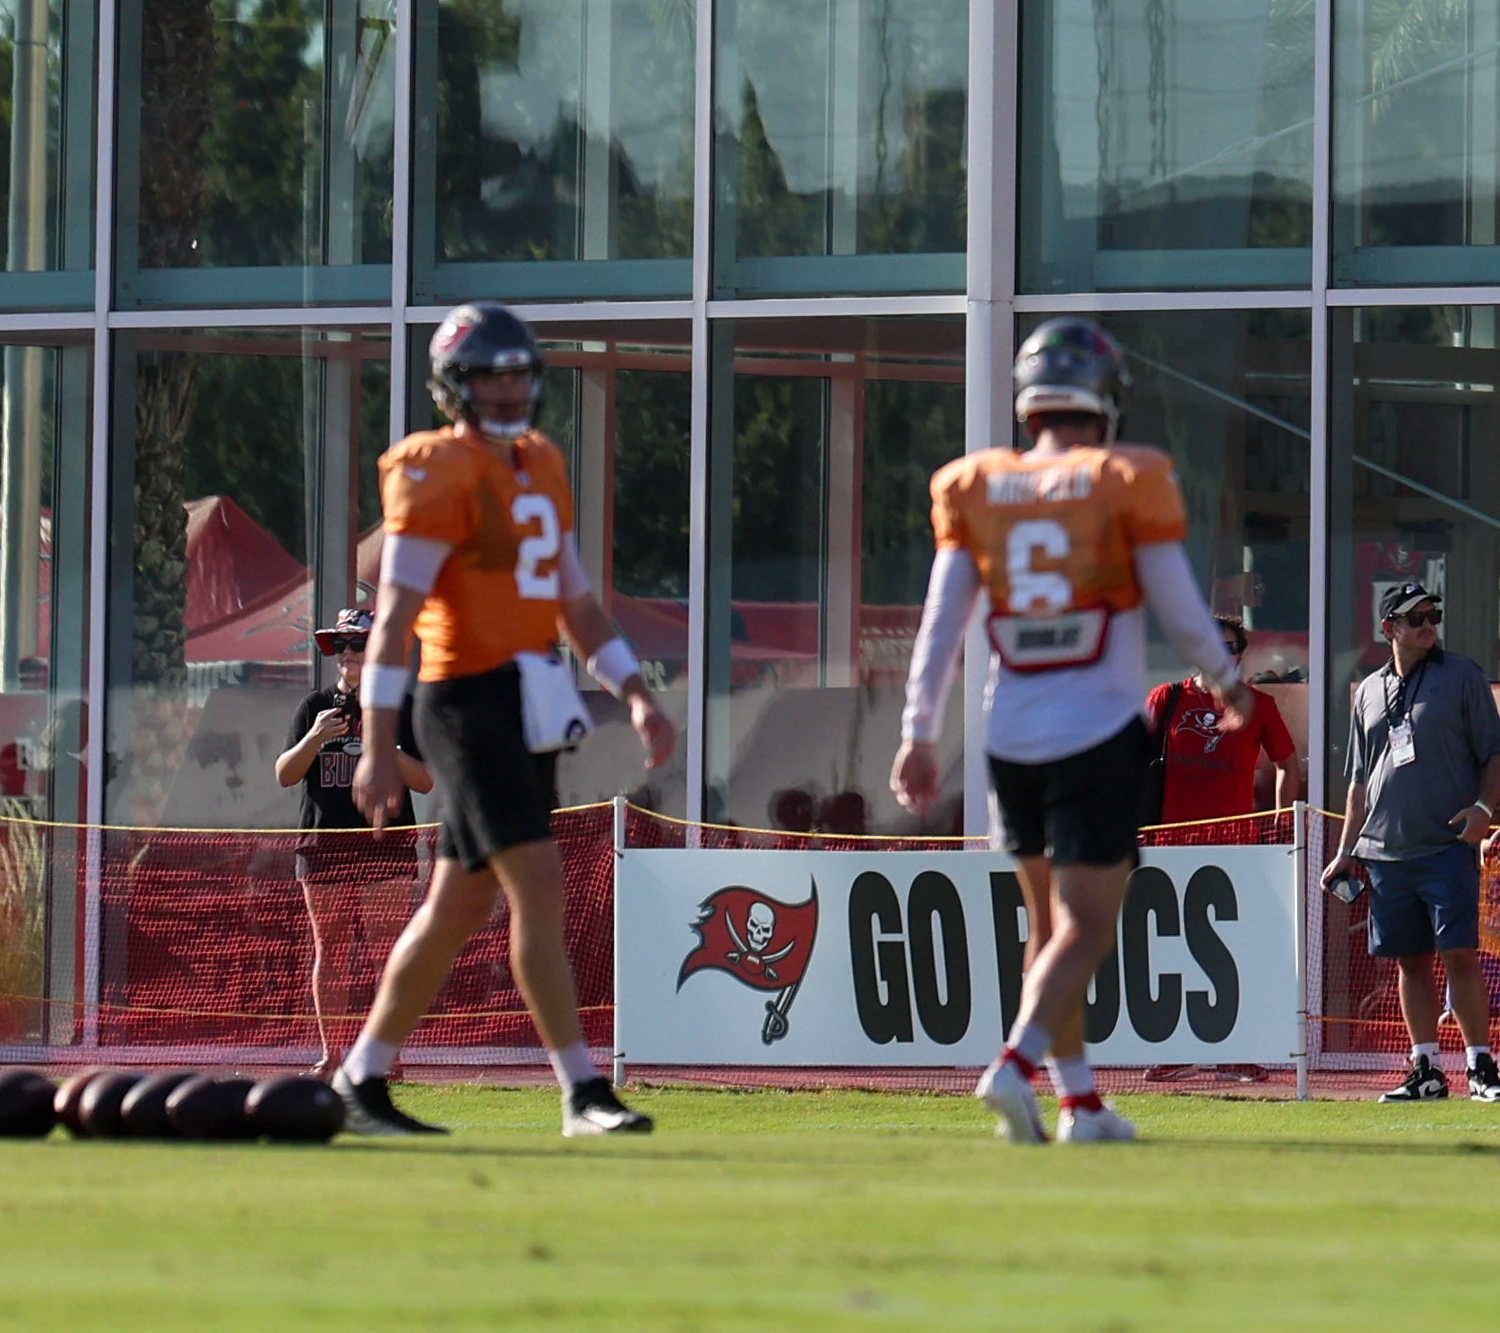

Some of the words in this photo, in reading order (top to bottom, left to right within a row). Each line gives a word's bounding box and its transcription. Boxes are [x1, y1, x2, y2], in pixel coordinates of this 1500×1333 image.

[511, 494, 560, 599] 2
[1007, 519, 1072, 617] 6
[319, 751, 360, 787] BU
[848, 870, 971, 1045] GO
[989, 865, 1240, 1044] BCS
